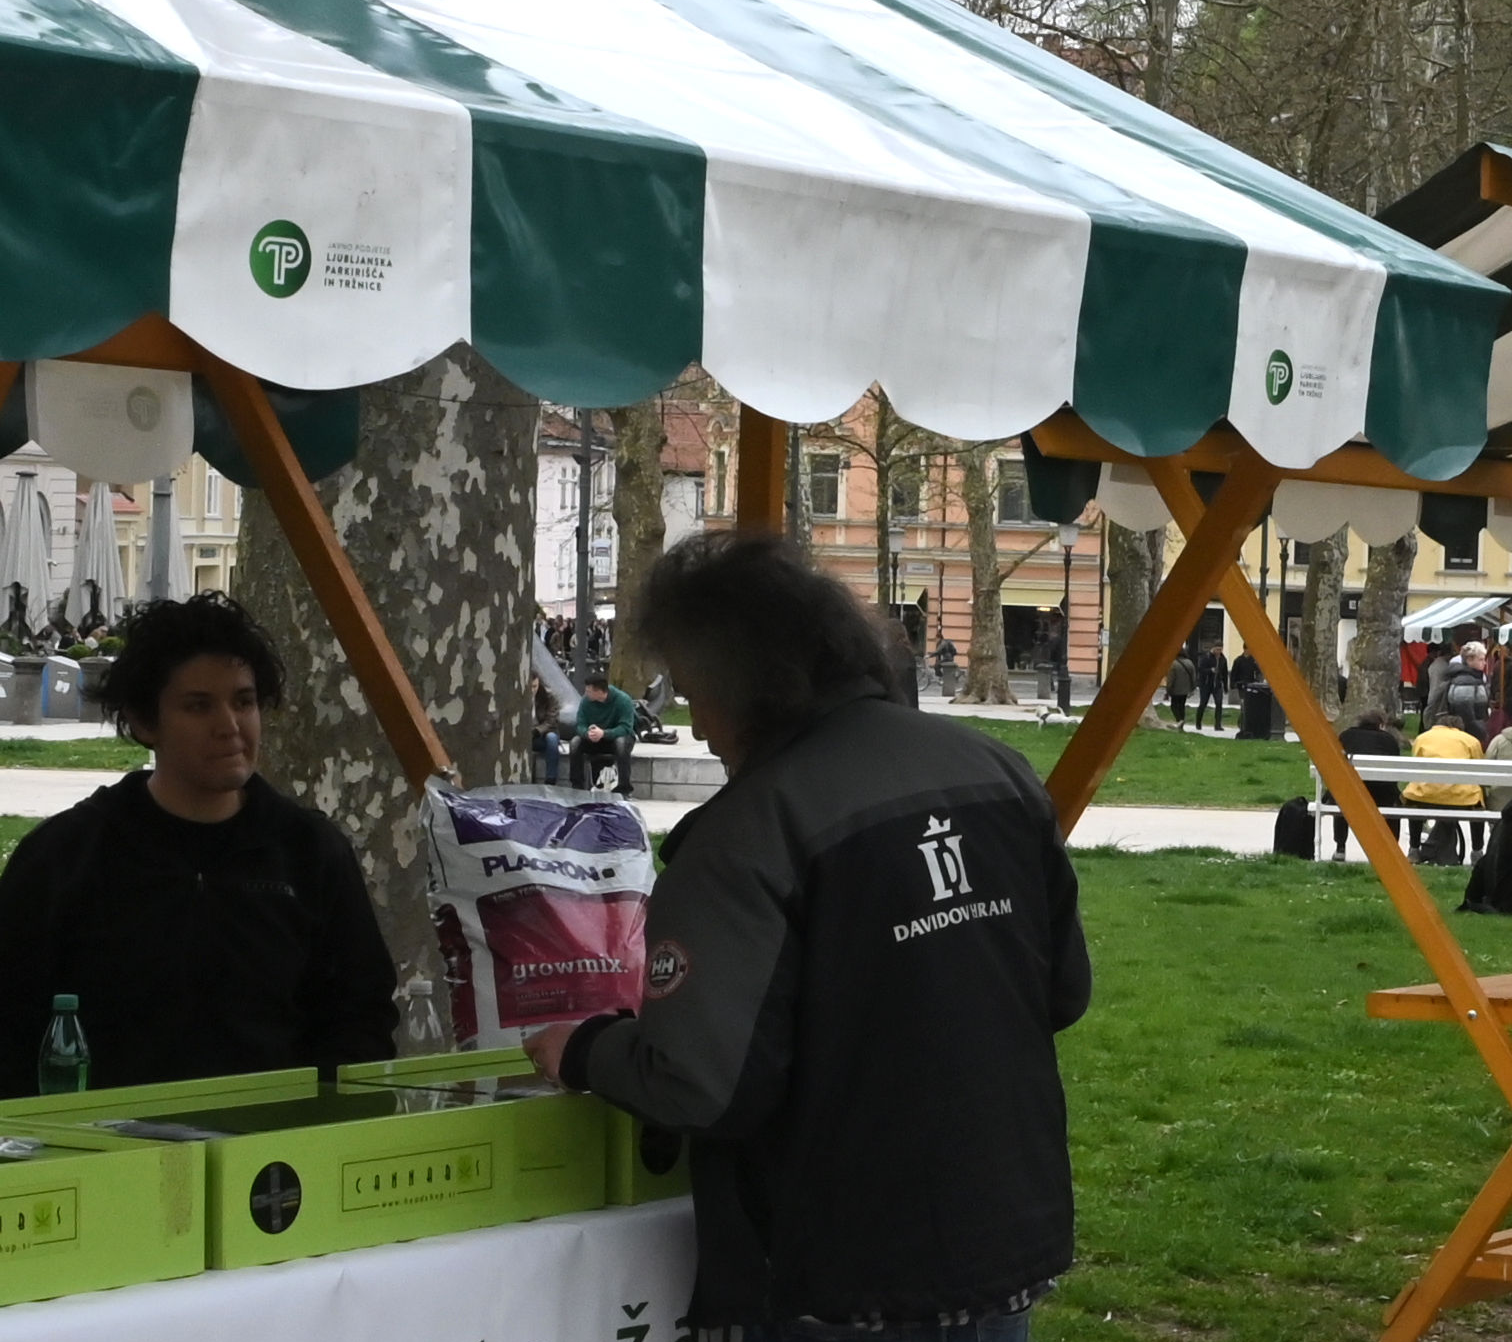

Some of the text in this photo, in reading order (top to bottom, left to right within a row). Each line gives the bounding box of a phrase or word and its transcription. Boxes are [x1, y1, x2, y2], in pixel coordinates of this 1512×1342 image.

[326, 253, 393, 268] LJUBLJANSKA
[324, 265, 385, 279] PARKIRIŠČA
[323, 277, 382, 291] IN TRŽNICE
